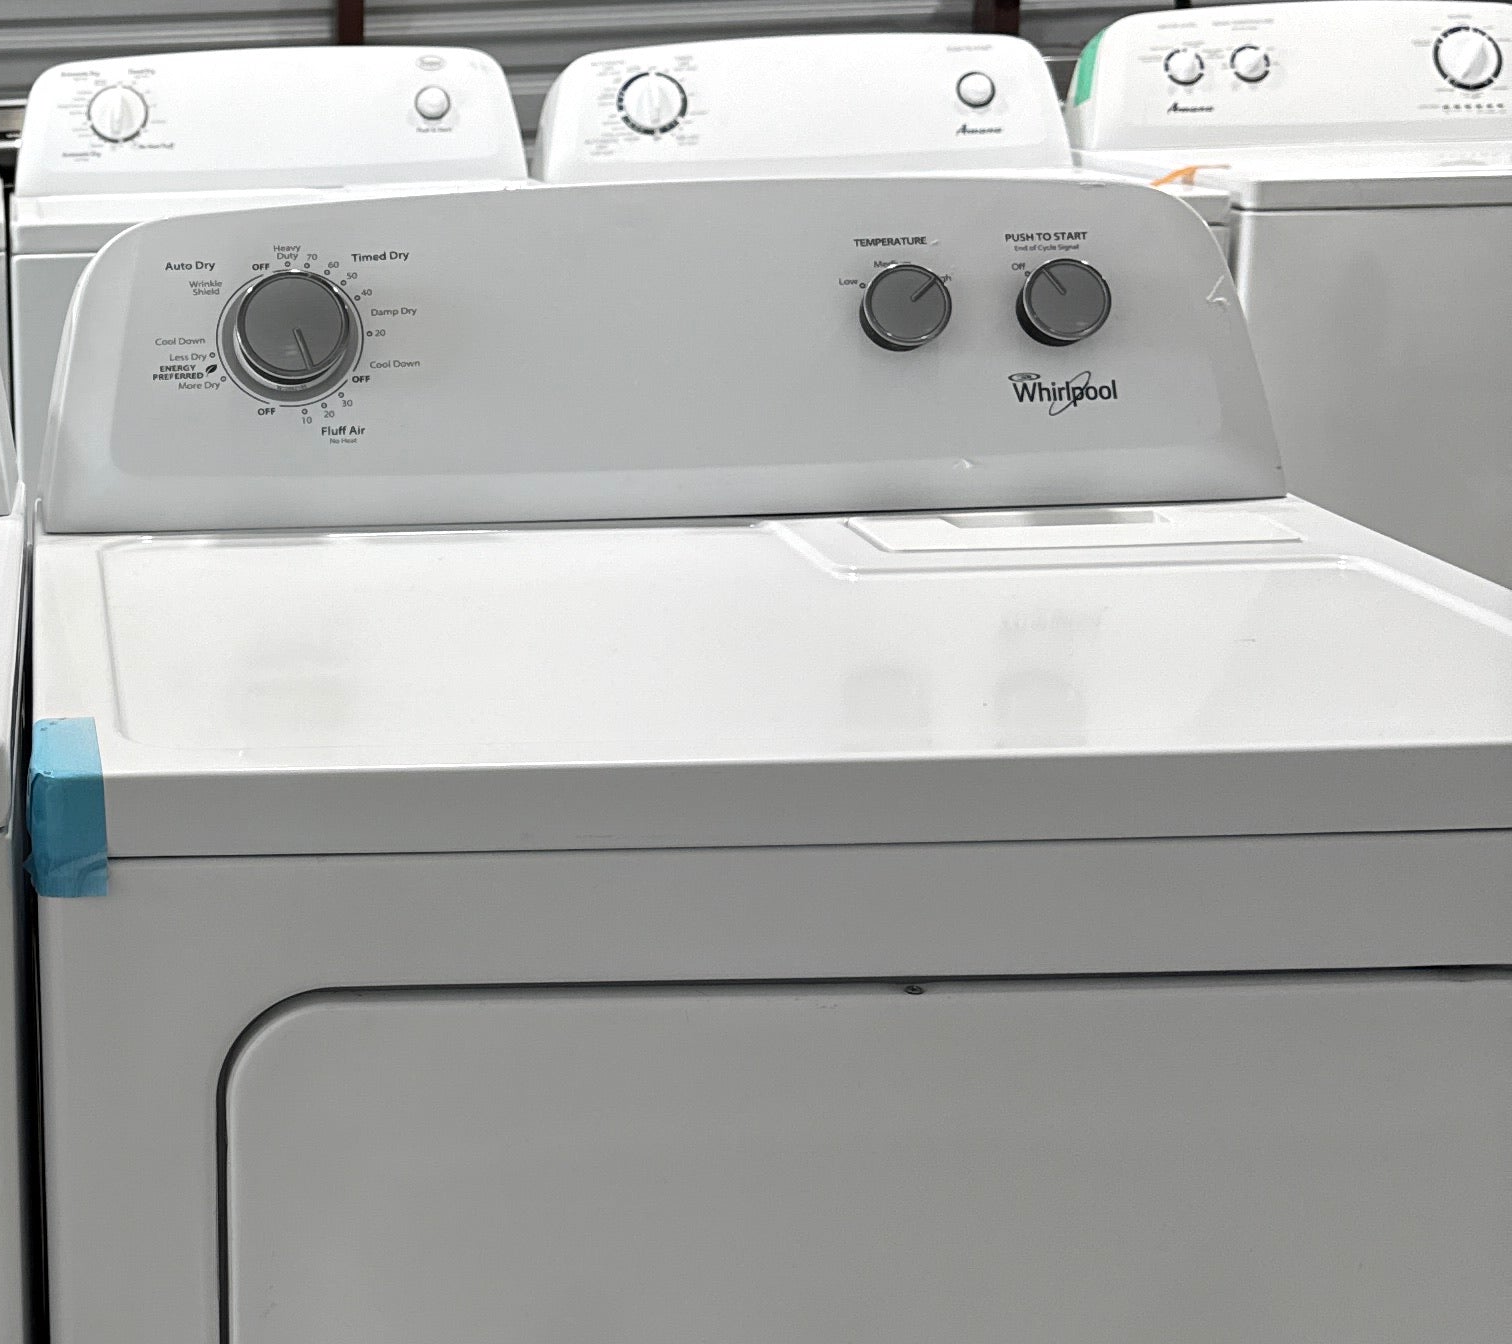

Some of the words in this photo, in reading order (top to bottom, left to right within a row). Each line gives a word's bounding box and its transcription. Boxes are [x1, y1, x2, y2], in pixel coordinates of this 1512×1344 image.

[853, 236, 927, 247] TEMPERATURE
[1005, 233, 1034, 242] PUSH
[1036, 233, 1051, 241] TO
[1053, 232, 1088, 241] START
[273, 245, 301, 253] Heavy
[276, 253, 299, 261] Duty
[351, 252, 387, 262] Timed
[389, 251, 410, 261] Dry
[165, 262, 192, 271] Auto
[196, 261, 216, 271] Dry
[252, 263, 270, 271] OFF
[1011, 262, 1026, 271] Off
[188, 280, 222, 288] Wrinkle
[838, 278, 858, 286] Low
[370, 308, 399, 316] Damp
[400, 307, 417, 316] Dry
[374, 329, 386, 337] 20
[155, 337, 176, 346] Cool
[178, 336, 206, 345] Down
[169, 354, 189, 362] Less
[191, 353, 207, 362] Dry
[159, 364, 196, 372] ENERGY
[369, 360, 391, 369] Cool
[393, 359, 421, 368] Down
[152, 372, 204, 381] PREFERRED
[178, 382, 202, 390] More
[204, 381, 220, 390] Dry
[1012, 379, 1118, 407] Whirlpool
[341, 399, 353, 407] 30
[257, 408, 276, 416] OFF
[323, 410, 335, 418] 20
[301, 416, 313, 424] 10
[321, 425, 346, 436] Fluff
[349, 425, 366, 435] Air
